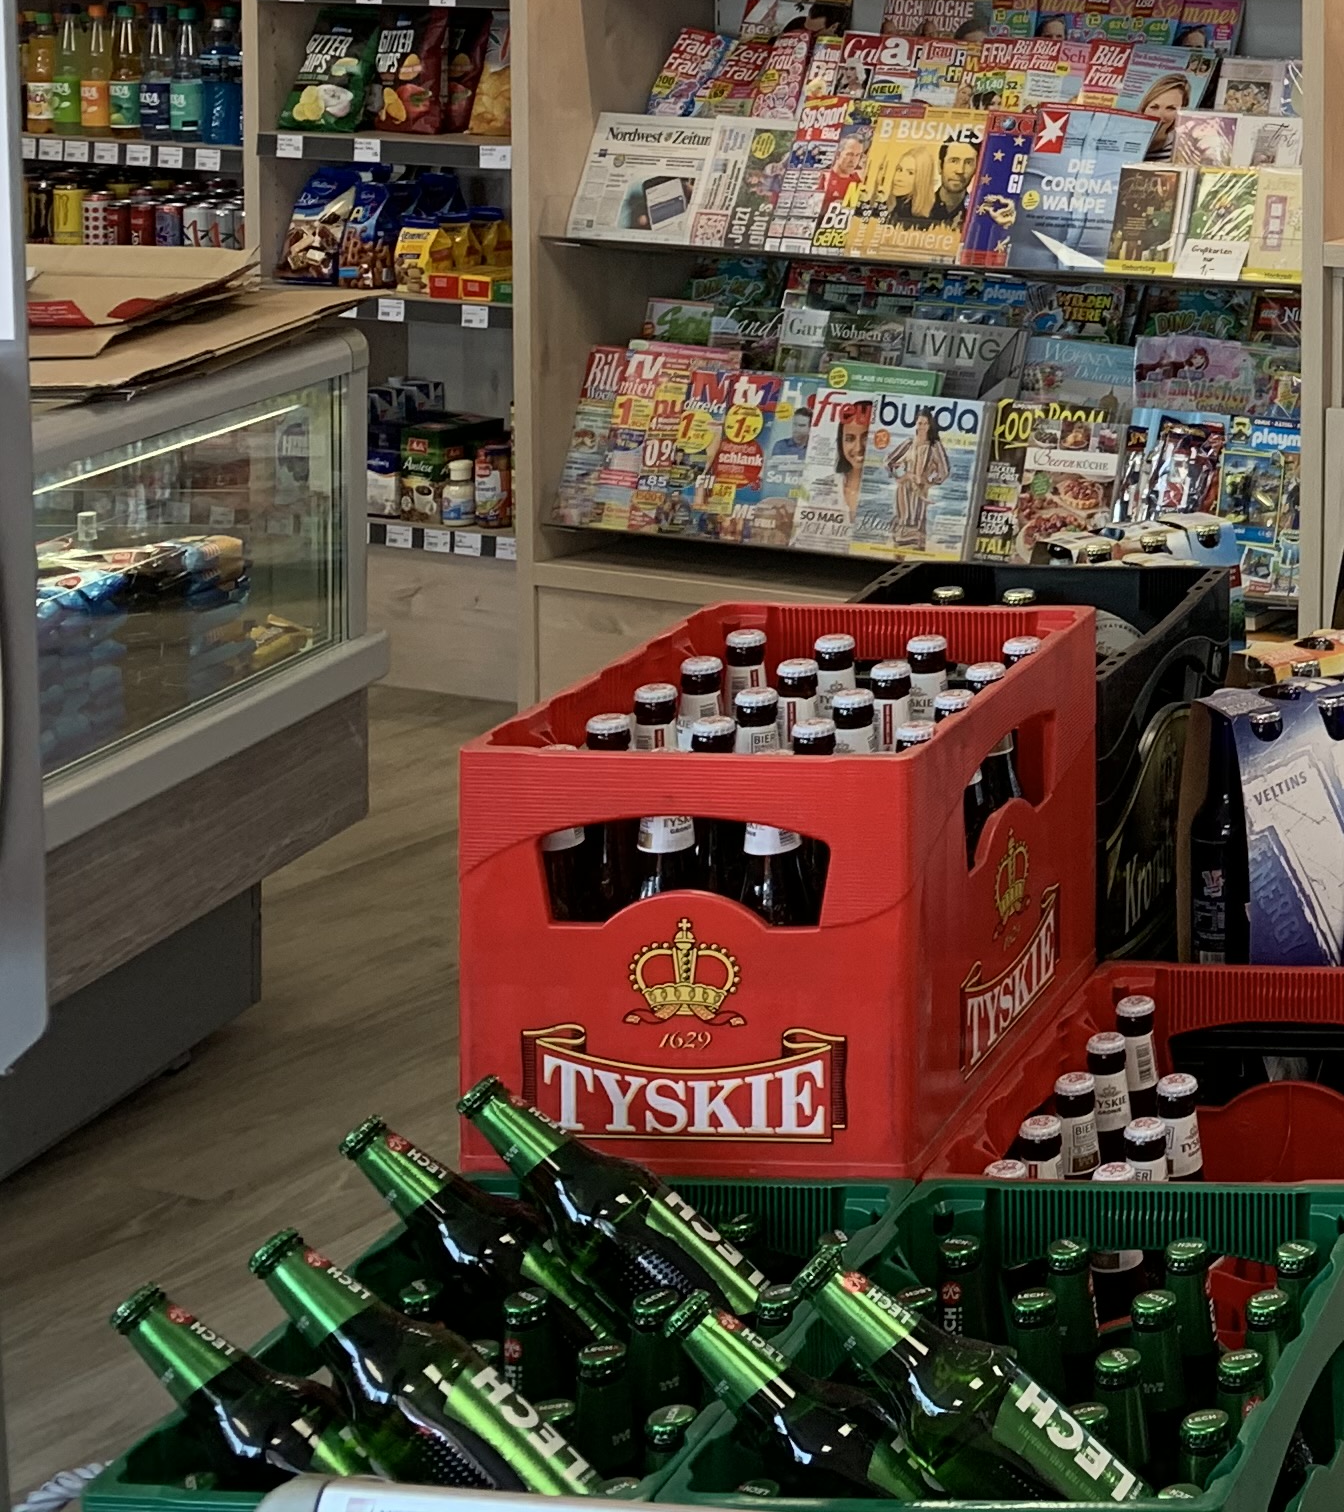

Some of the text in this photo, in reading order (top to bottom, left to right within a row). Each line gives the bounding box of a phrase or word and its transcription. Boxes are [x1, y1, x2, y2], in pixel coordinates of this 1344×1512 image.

[379, 30, 412, 53] GITTER
[672, 35, 710, 57] Frau
[664, 55, 701, 76] Frau
[732, 46, 767, 64] Zeit
[1094, 44, 1130, 68] Bild
[719, 62, 758, 81] Frau
[1085, 68, 1123, 88] Frau
[871, 84, 901, 94] NEU!
[817, 104, 847, 127] Sport
[606, 128, 663, 143] Nordwest
[1068, 159, 1096, 175] DIE
[1042, 194, 1106, 214] WAMPE
[829, 322, 882, 342] Wohnen
[905, 328, 999, 363] LIVING
[879, 395, 979, 435] burda
[800, 510, 815, 521] SO
[1252, 770, 1309, 807] VELTINS
[966, 908, 1058, 1068] TYSKIE
[658, 1029, 711, 1050] 1629
[542, 1054, 826, 1136] TYSKIE
[407, 1147, 449, 1180] LECH
[326, 1264, 371, 1299] LECH
[867, 1287, 914, 1324] LECH
[740, 1325, 785, 1364] LECH
[471, 1368, 593, 1488] LECH
[1014, 1383, 1142, 1502] LECH
